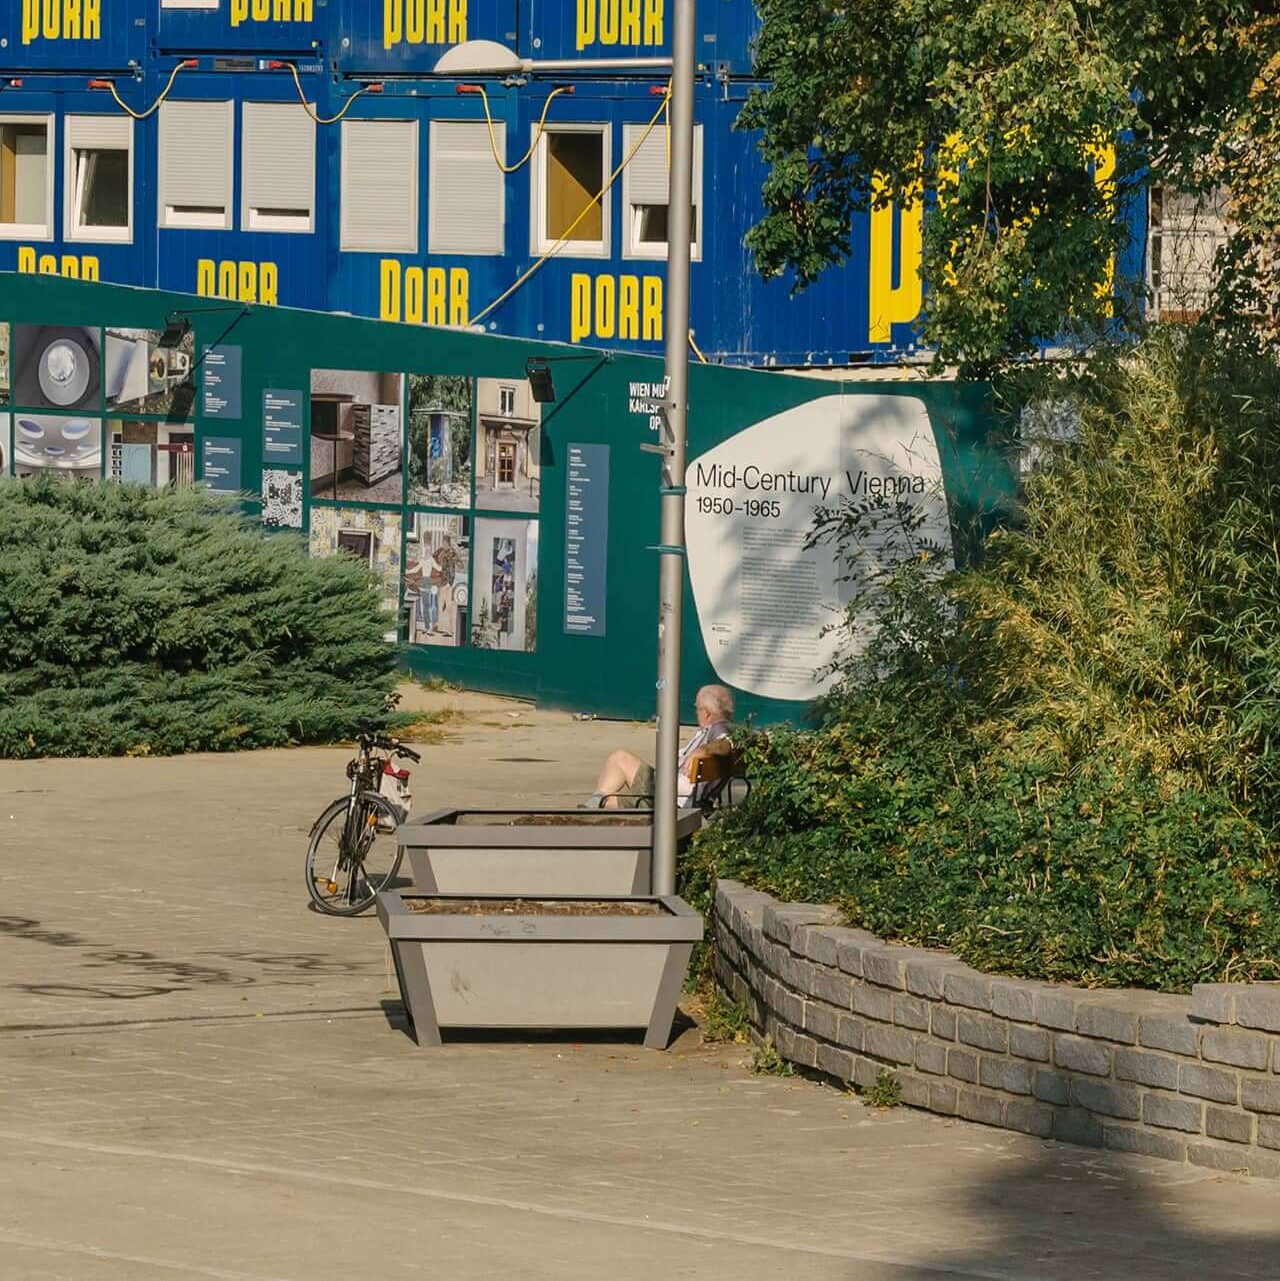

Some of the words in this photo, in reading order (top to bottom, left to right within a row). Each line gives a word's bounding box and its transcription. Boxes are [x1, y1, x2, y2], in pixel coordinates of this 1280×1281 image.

[571, 274, 663, 343] PORR
[629, 381, 650, 397] WIEN
[651, 382, 665, 398] MU
[629, 398, 660, 413] KARLS
[649, 415, 661, 430] OP
[696, 463, 832, 500] Mid-Century
[845, 470, 926, 495] Vienna
[696, 496, 782, 518] 1950–1965
